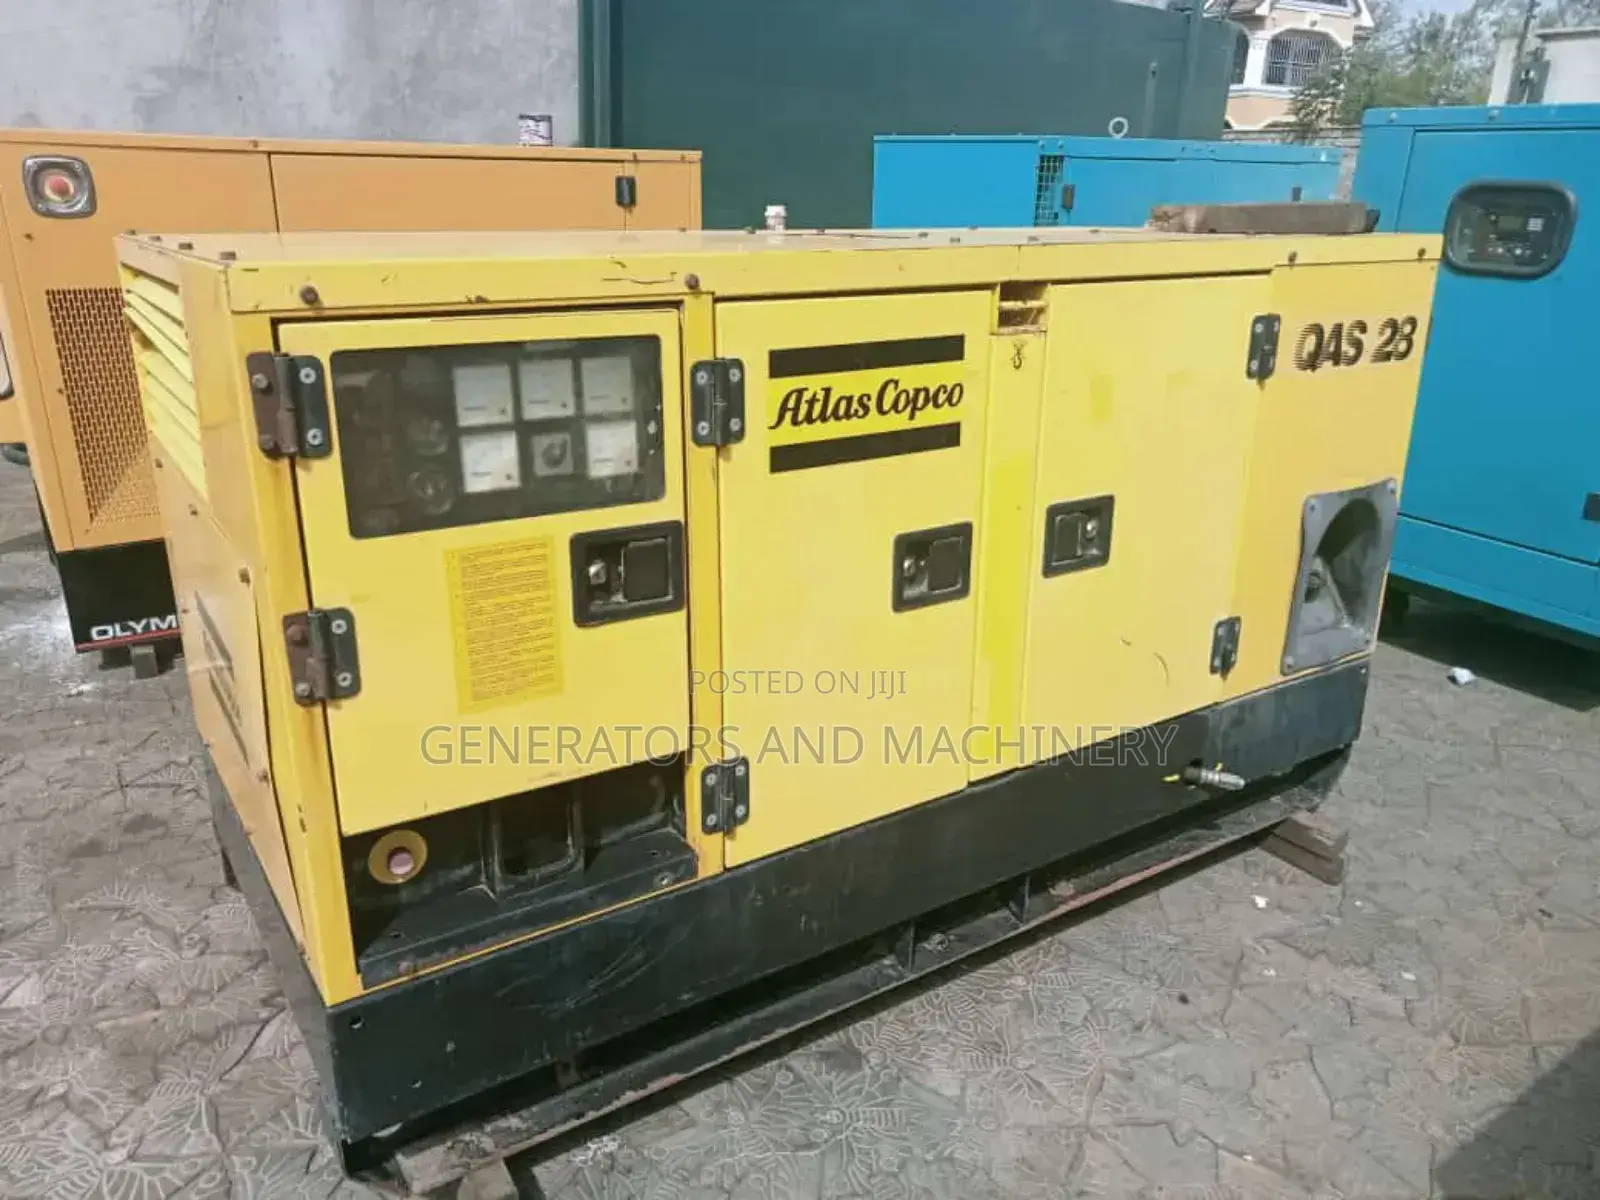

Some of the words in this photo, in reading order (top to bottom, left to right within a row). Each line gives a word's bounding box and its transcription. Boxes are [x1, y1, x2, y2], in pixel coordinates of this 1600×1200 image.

[1292, 319, 1368, 374] QAS
[1370, 315, 1418, 364] 28
[768, 386, 871, 430] Atlas
[875, 378, 964, 421] Copco
